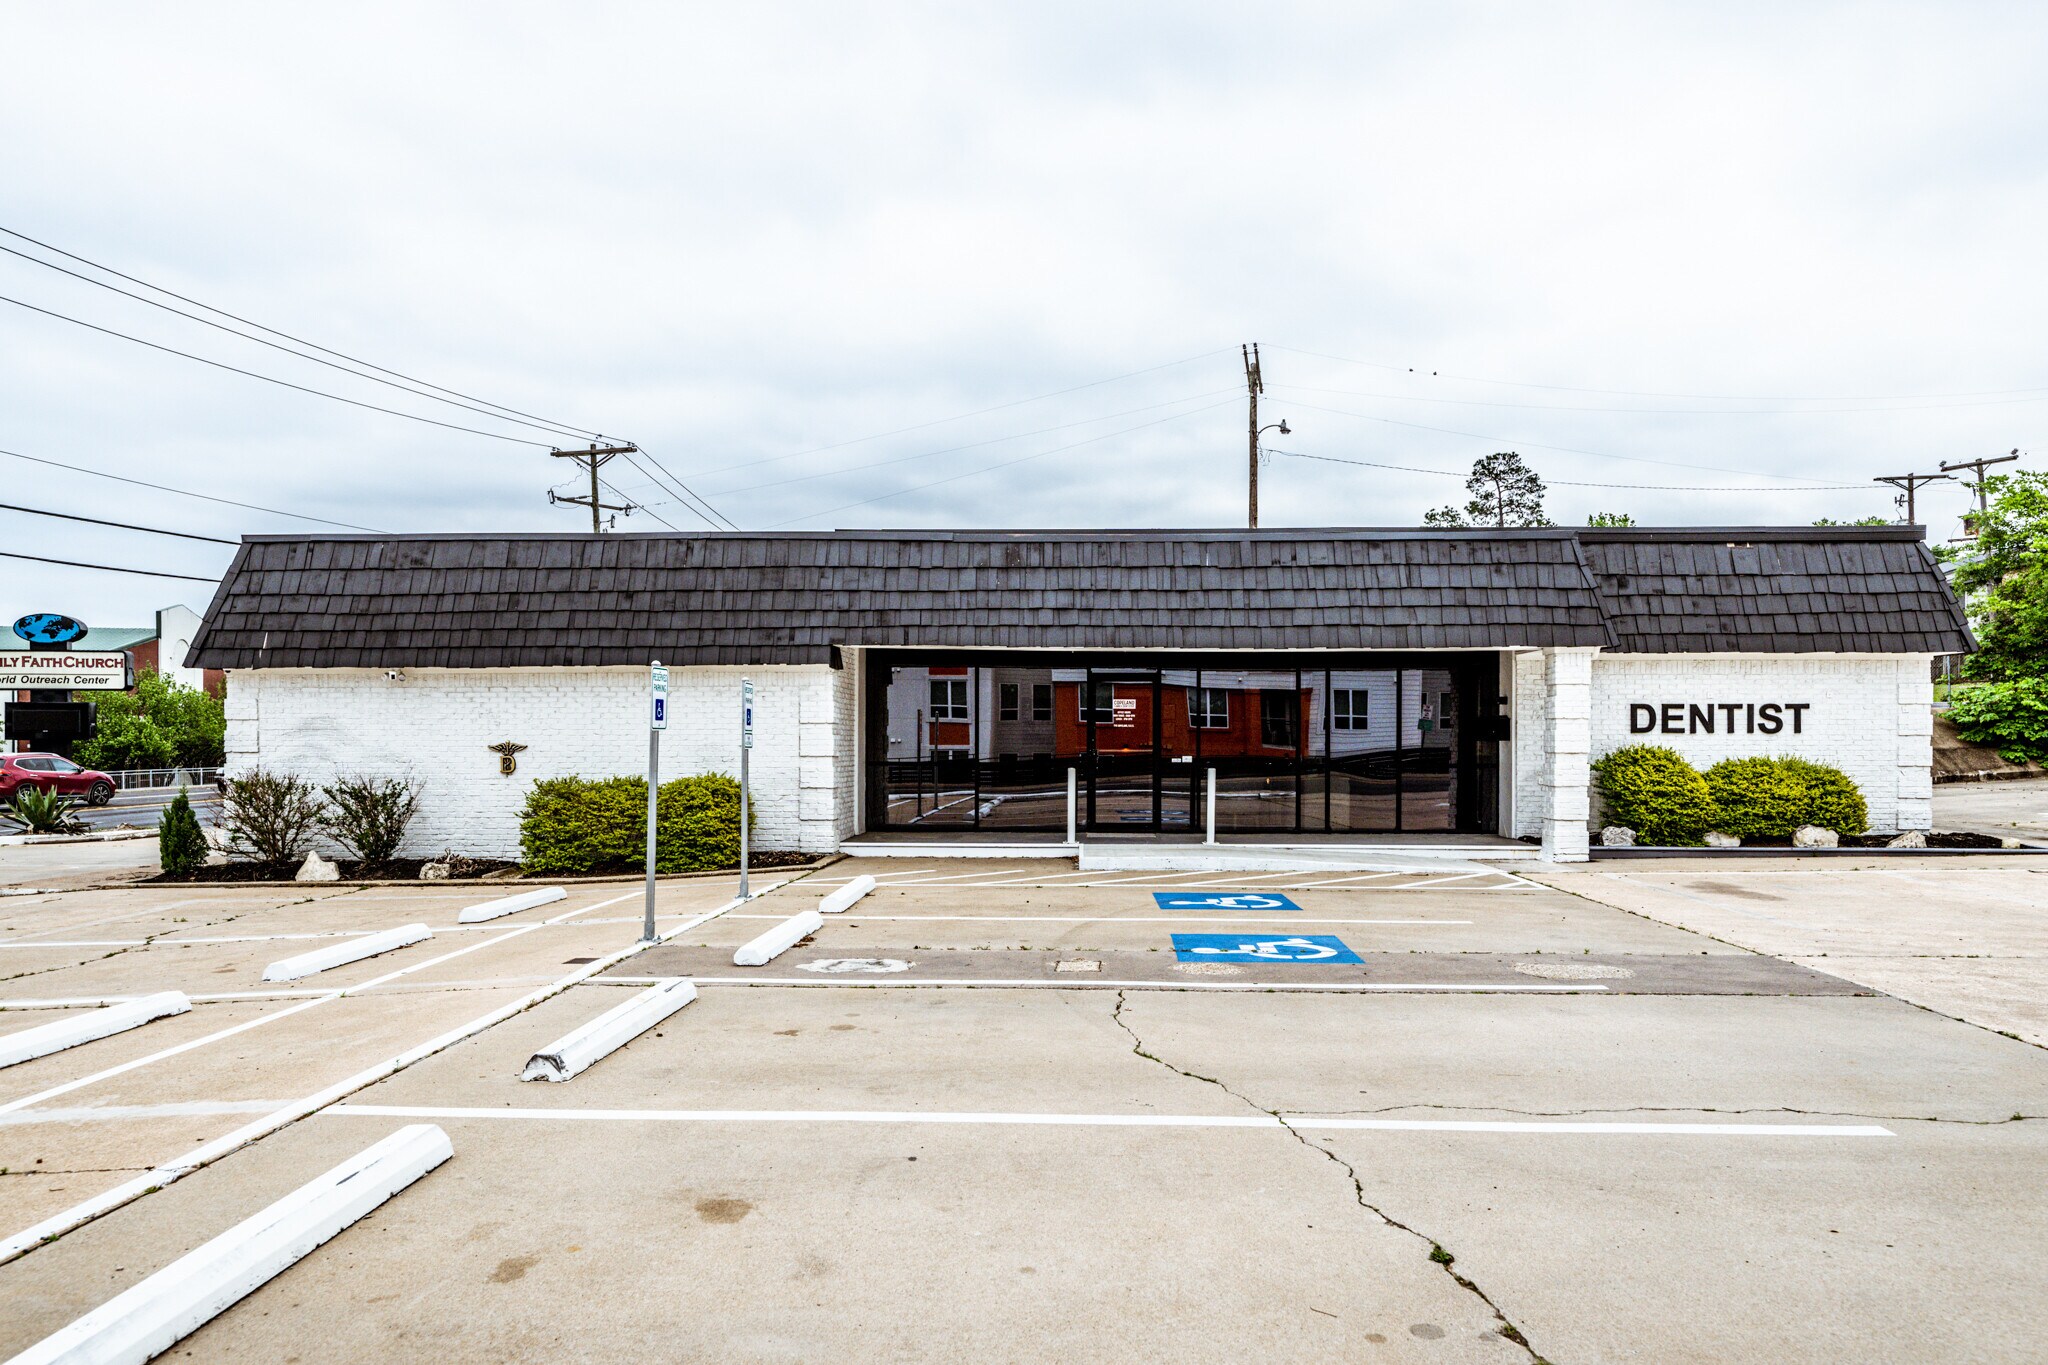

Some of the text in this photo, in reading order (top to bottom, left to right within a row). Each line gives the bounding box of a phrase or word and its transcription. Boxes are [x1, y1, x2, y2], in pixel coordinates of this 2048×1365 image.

[20, 675, 70, 684] Outreach
[74, 675, 110, 684] Center
[1630, 703, 1810, 734] DENTIST
